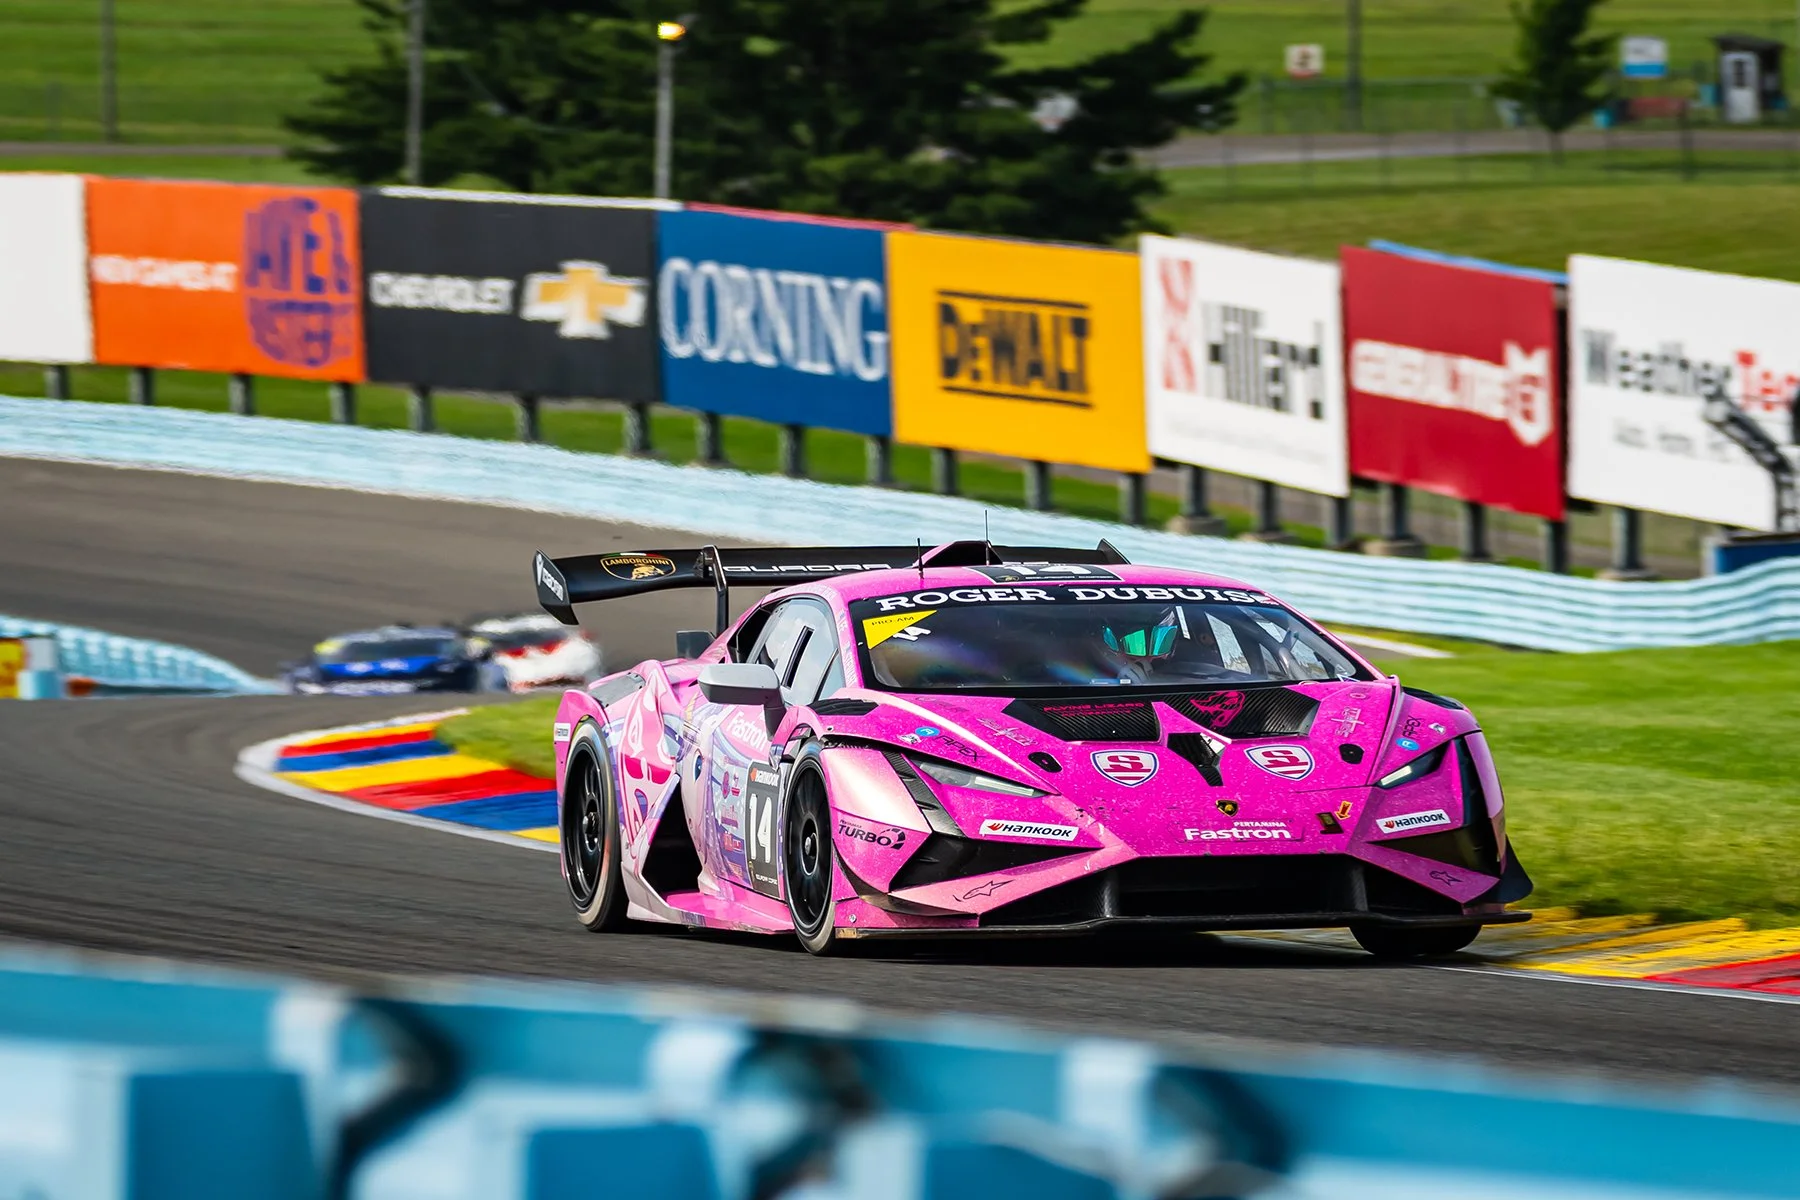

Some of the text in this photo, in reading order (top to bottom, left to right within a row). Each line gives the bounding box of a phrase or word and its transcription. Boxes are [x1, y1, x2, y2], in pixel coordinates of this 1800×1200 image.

[369, 271, 515, 314] CHEVROLET
[658, 257, 887, 382] CORNING
[604, 558, 670, 567] LAMBORGHINI
[708, 563, 892, 572] QUADRA
[875, 588, 1056, 611] ROGER
[1067, 586, 1257, 604] DUBUIS
[726, 710, 767, 752] Fastron
[933, 734, 987, 763] APEX
[749, 793, 773, 864] 14
[838, 824, 892, 846] TURBO
[1183, 827, 1292, 841] Fastron
[1233, 820, 1287, 828] PERTAMINA
